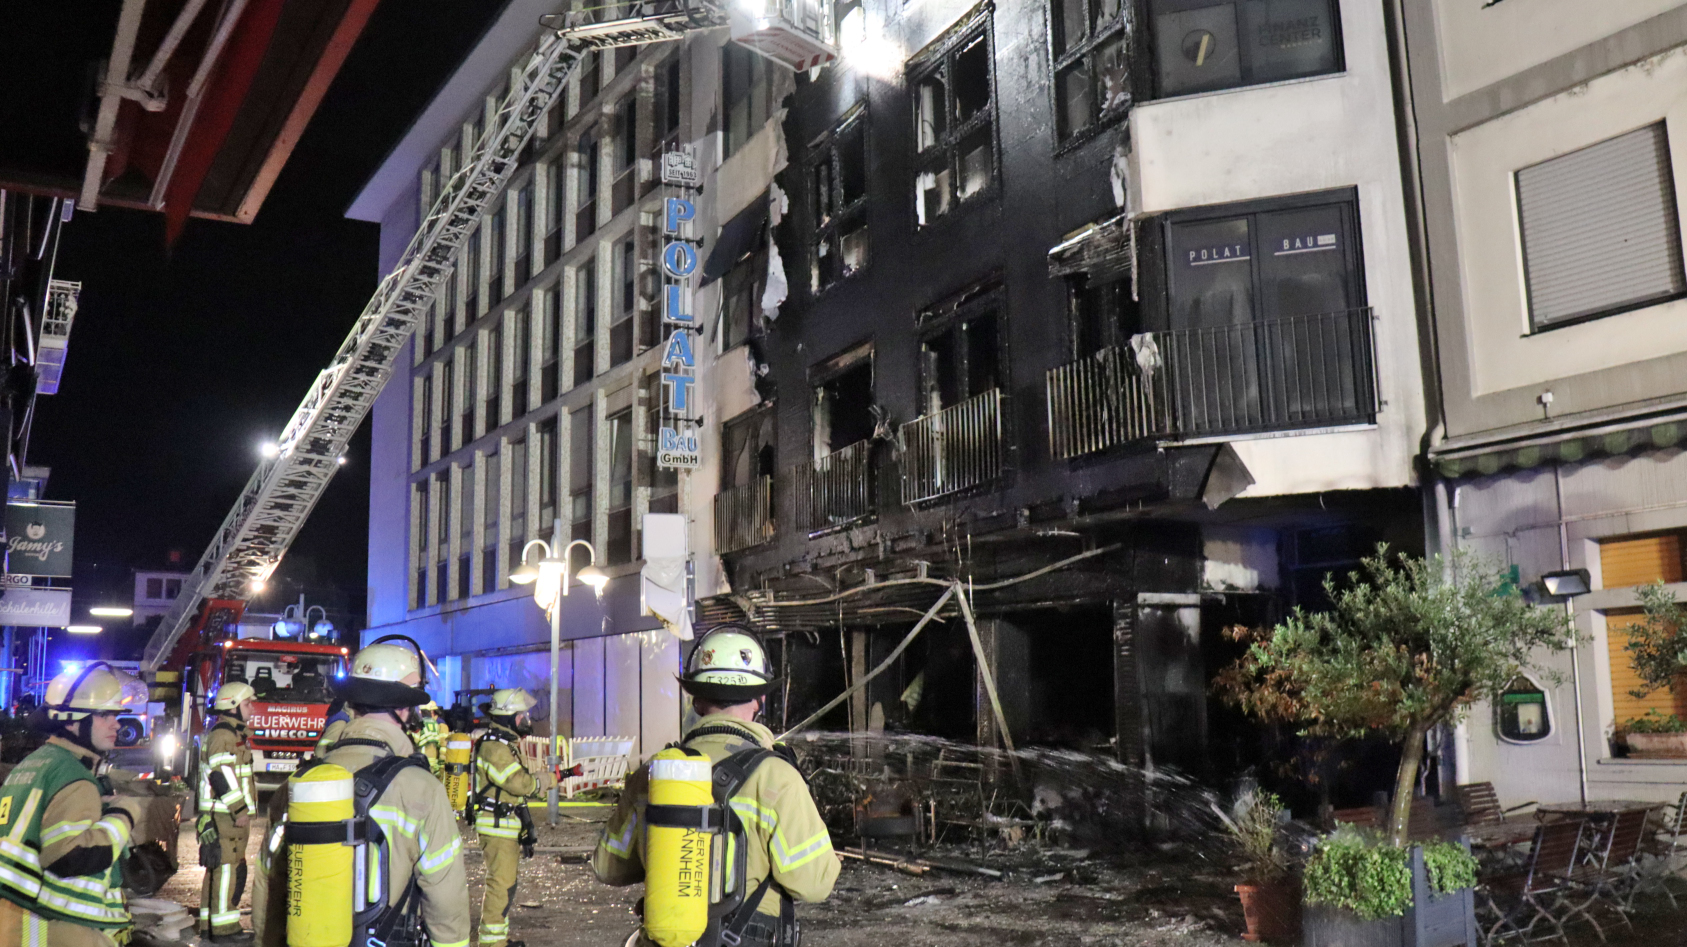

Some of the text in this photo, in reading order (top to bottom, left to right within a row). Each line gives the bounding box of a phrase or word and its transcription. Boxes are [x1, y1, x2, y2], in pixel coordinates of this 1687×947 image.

[1259, 27, 1322, 47] CENTER
[668, 169, 680, 177] SEIT
[1189, 245, 1241, 261] POLAT
[1283, 235, 1314, 250] BAU
[663, 197, 697, 412] POLAT
[663, 453, 698, 465] GmbH
[6, 536, 64, 561] Jamy's
[267, 705, 308, 713] MAGIRUS
[246, 715, 326, 729] FEUERWEHR
[264, 729, 307, 739] IVECO
[677, 827, 696, 898] ANNHEIM
[693, 831, 705, 898] UERWEHR
[293, 844, 304, 917] EUERWEHR
